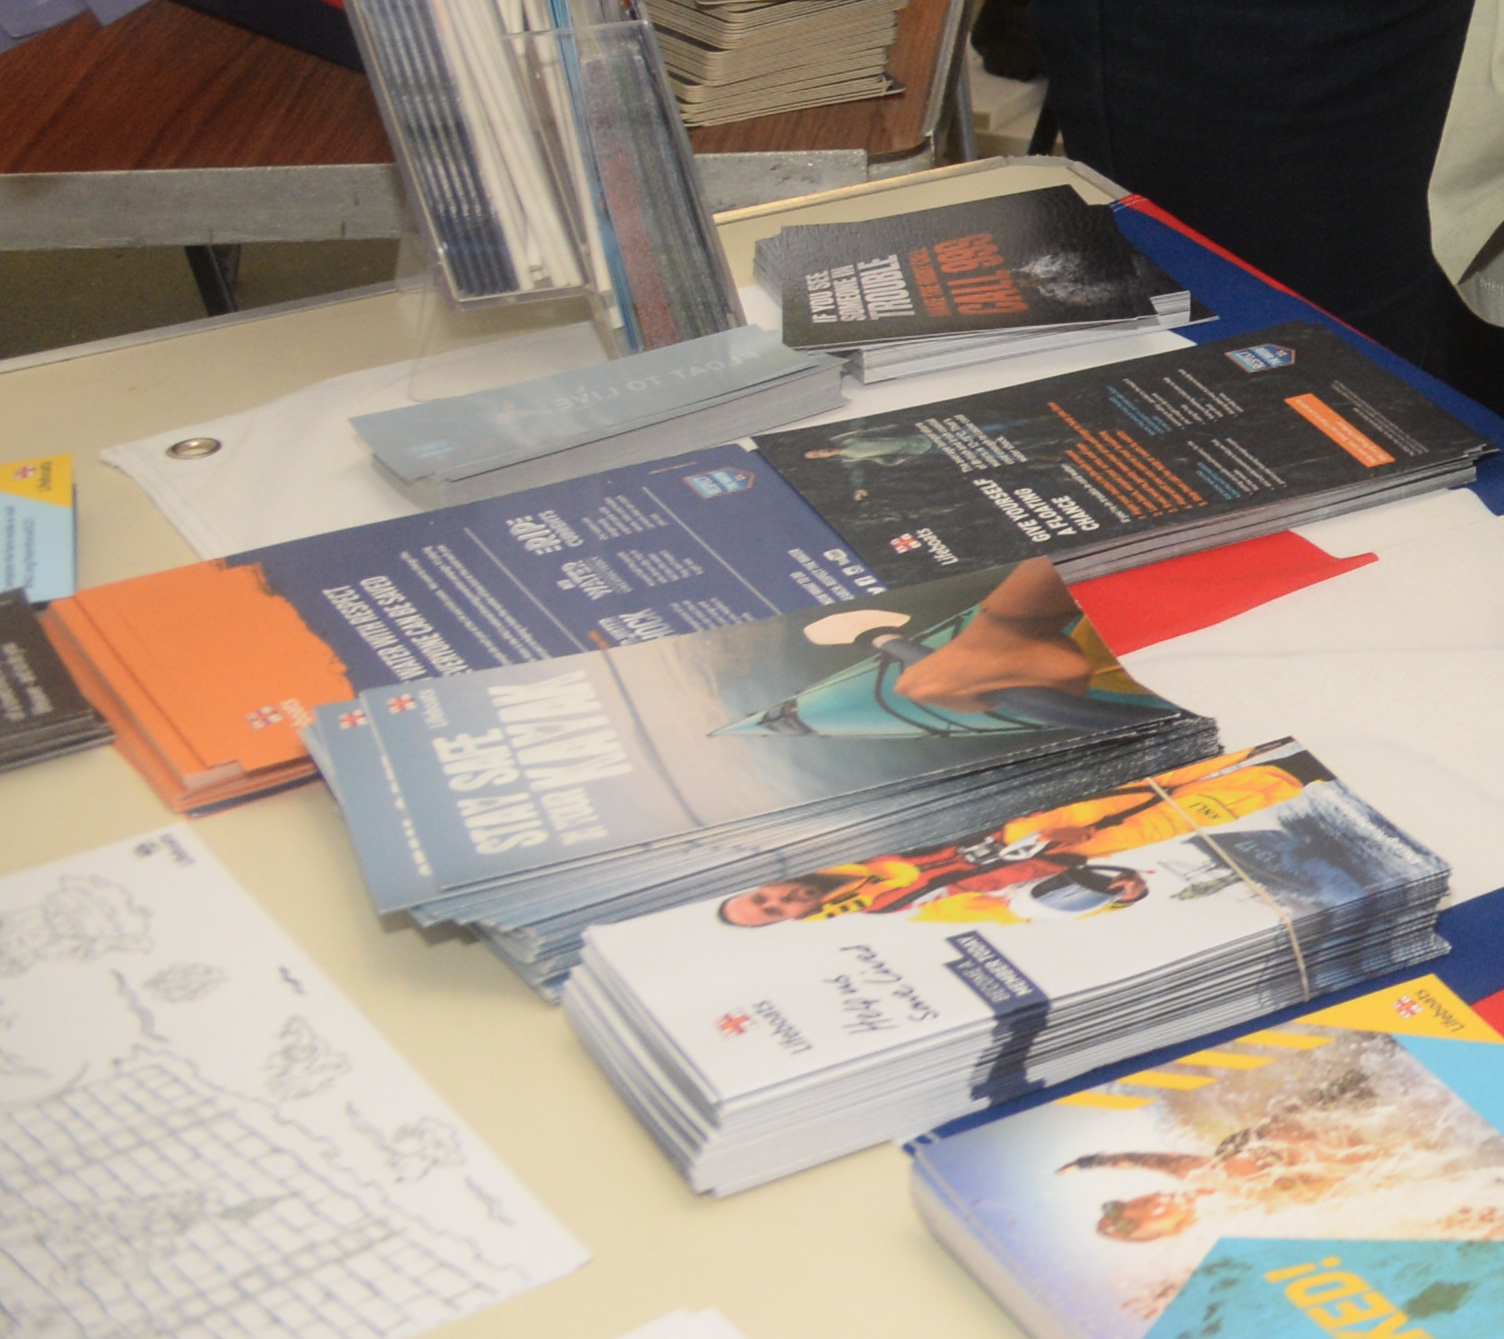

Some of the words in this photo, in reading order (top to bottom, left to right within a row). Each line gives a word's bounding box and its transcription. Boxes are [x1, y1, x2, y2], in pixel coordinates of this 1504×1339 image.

[933, 232, 1004, 273] 999
[806, 270, 831, 291] SEE
[830, 264, 856, 280] IN
[856, 254, 916, 321] TROUBLE
[809, 290, 836, 313] YOU
[832, 276, 867, 322] SOMEONE
[948, 270, 1029, 315] CALL
[813, 314, 838, 324] IF
[972, 478, 1030, 523] YOURSELF
[1014, 487, 1069, 529] FLOATING
[1051, 495, 1101, 532] CHANCE
[916, 527, 959, 566] Lifeboats
[1017, 517, 1052, 543] GIVE
[322, 585, 379, 625] RESPECT
[359, 575, 406, 606] SAVED
[383, 601, 418, 618] BE
[355, 621, 399, 650] WITH
[395, 614, 434, 638] CAN
[377, 644, 427, 681] WATER
[487, 669, 634, 792] KAYAK
[432, 727, 520, 792] SAFE
[456, 792, 549, 855] STAY
[957, 935, 991, 964] TODAY
[986, 960, 1033, 998] MEMBER
[752, 999, 813, 1056] Lifeboats
[1415, 988, 1467, 1033] Lifeboats
